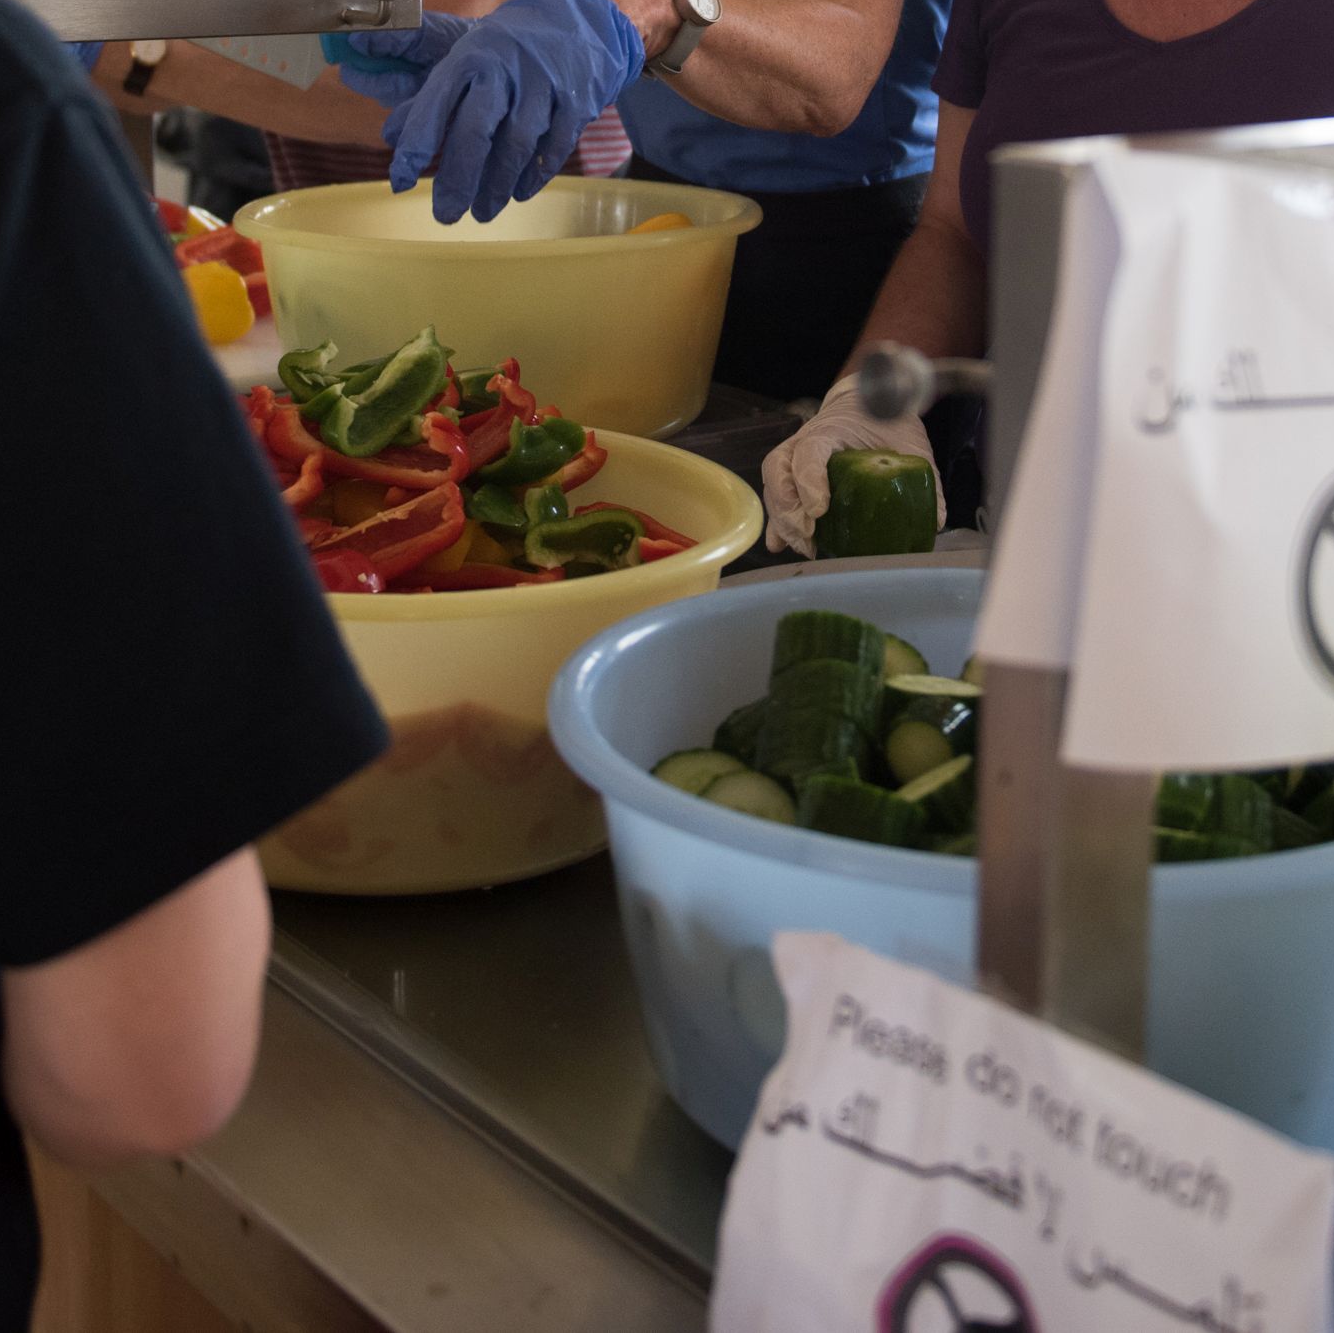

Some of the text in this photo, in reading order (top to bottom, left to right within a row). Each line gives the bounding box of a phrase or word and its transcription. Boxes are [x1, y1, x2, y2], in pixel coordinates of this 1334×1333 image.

[827, 992, 1237, 1224] Please do not touch
